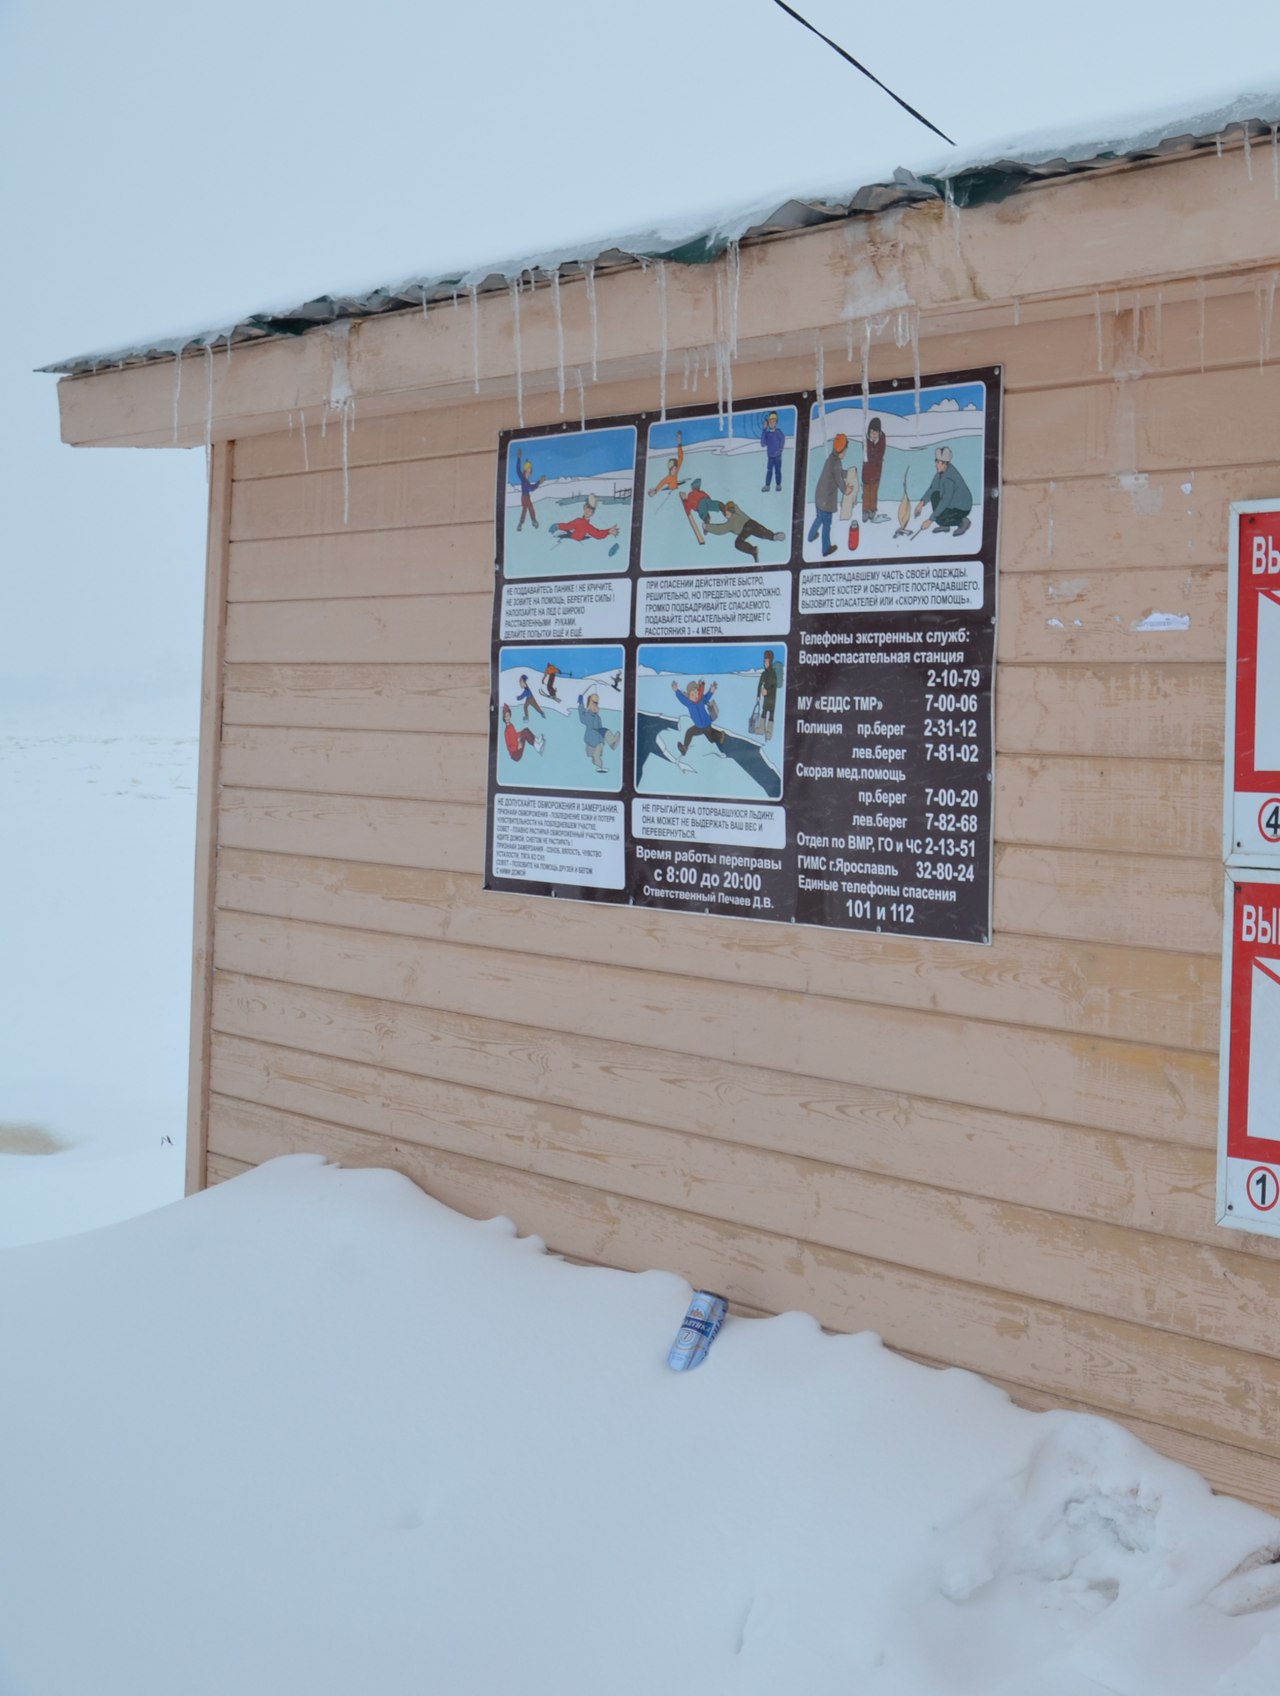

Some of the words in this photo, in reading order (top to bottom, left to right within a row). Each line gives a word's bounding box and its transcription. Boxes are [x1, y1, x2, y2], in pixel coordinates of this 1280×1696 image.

[863, 585, 868, 593] И
[800, 631, 853, 646] Телефоны
[856, 631, 923, 644] экстренных
[926, 628, 970, 646] служб:
[799, 651, 910, 666] Водно-спасательная
[914, 652, 964, 664] станция
[927, 669, 980, 687] 2-10-79
[798, 697, 812, 710] МУ
[854, 697, 883, 711] ТМР»
[925, 694, 977, 711] 7-00-06
[797, 720, 842, 735] Полиция
[858, 721, 905, 738] пр.берег
[924, 719, 976, 737] 2-31-12
[852, 745, 906, 762] лев.берег
[926, 744, 979, 762] 7-81-02
[796, 763, 833, 780] Скорая
[837, 767, 906, 782] мед.помощь
[859, 790, 907, 806] пр.берег
[925, 789, 978, 807] 7-00-20
[853, 814, 907, 830] лев.берег
[926, 813, 977, 832] 7-82-68
[1266, 805, 1280, 834] 4
[797, 832, 828, 848] Отдел
[832, 835, 845, 848] по
[848, 836, 875, 853] ВМР,
[878, 837, 893, 851] ГО
[897, 841, 902, 852] и
[906, 840, 921, 853] ЧС
[925, 837, 975, 857] 2-13-51
[636, 846, 671, 860] Время
[675, 850, 716, 864] работы
[719, 855, 782, 870] переправы
[798, 855, 826, 870] ГИМС
[829, 858, 898, 876] г.Ярославль
[916, 862, 974, 881] 32-80-24
[654, 869, 662, 881] с
[666, 866, 697, 884] 8:00
[701, 872, 720, 888] до
[723, 871, 761, 891] 20:00
[798, 875, 838, 891] Единые
[841, 881, 899, 897] телефоны
[903, 886, 956, 901] спасения
[643, 886, 716, 903] Ответственный
[718, 893, 751, 906] Печаев
[847, 900, 871, 918] 101
[877, 906, 885, 920] и
[891, 903, 914, 922] 112
[1255, 1174, 1267, 1205] 1
